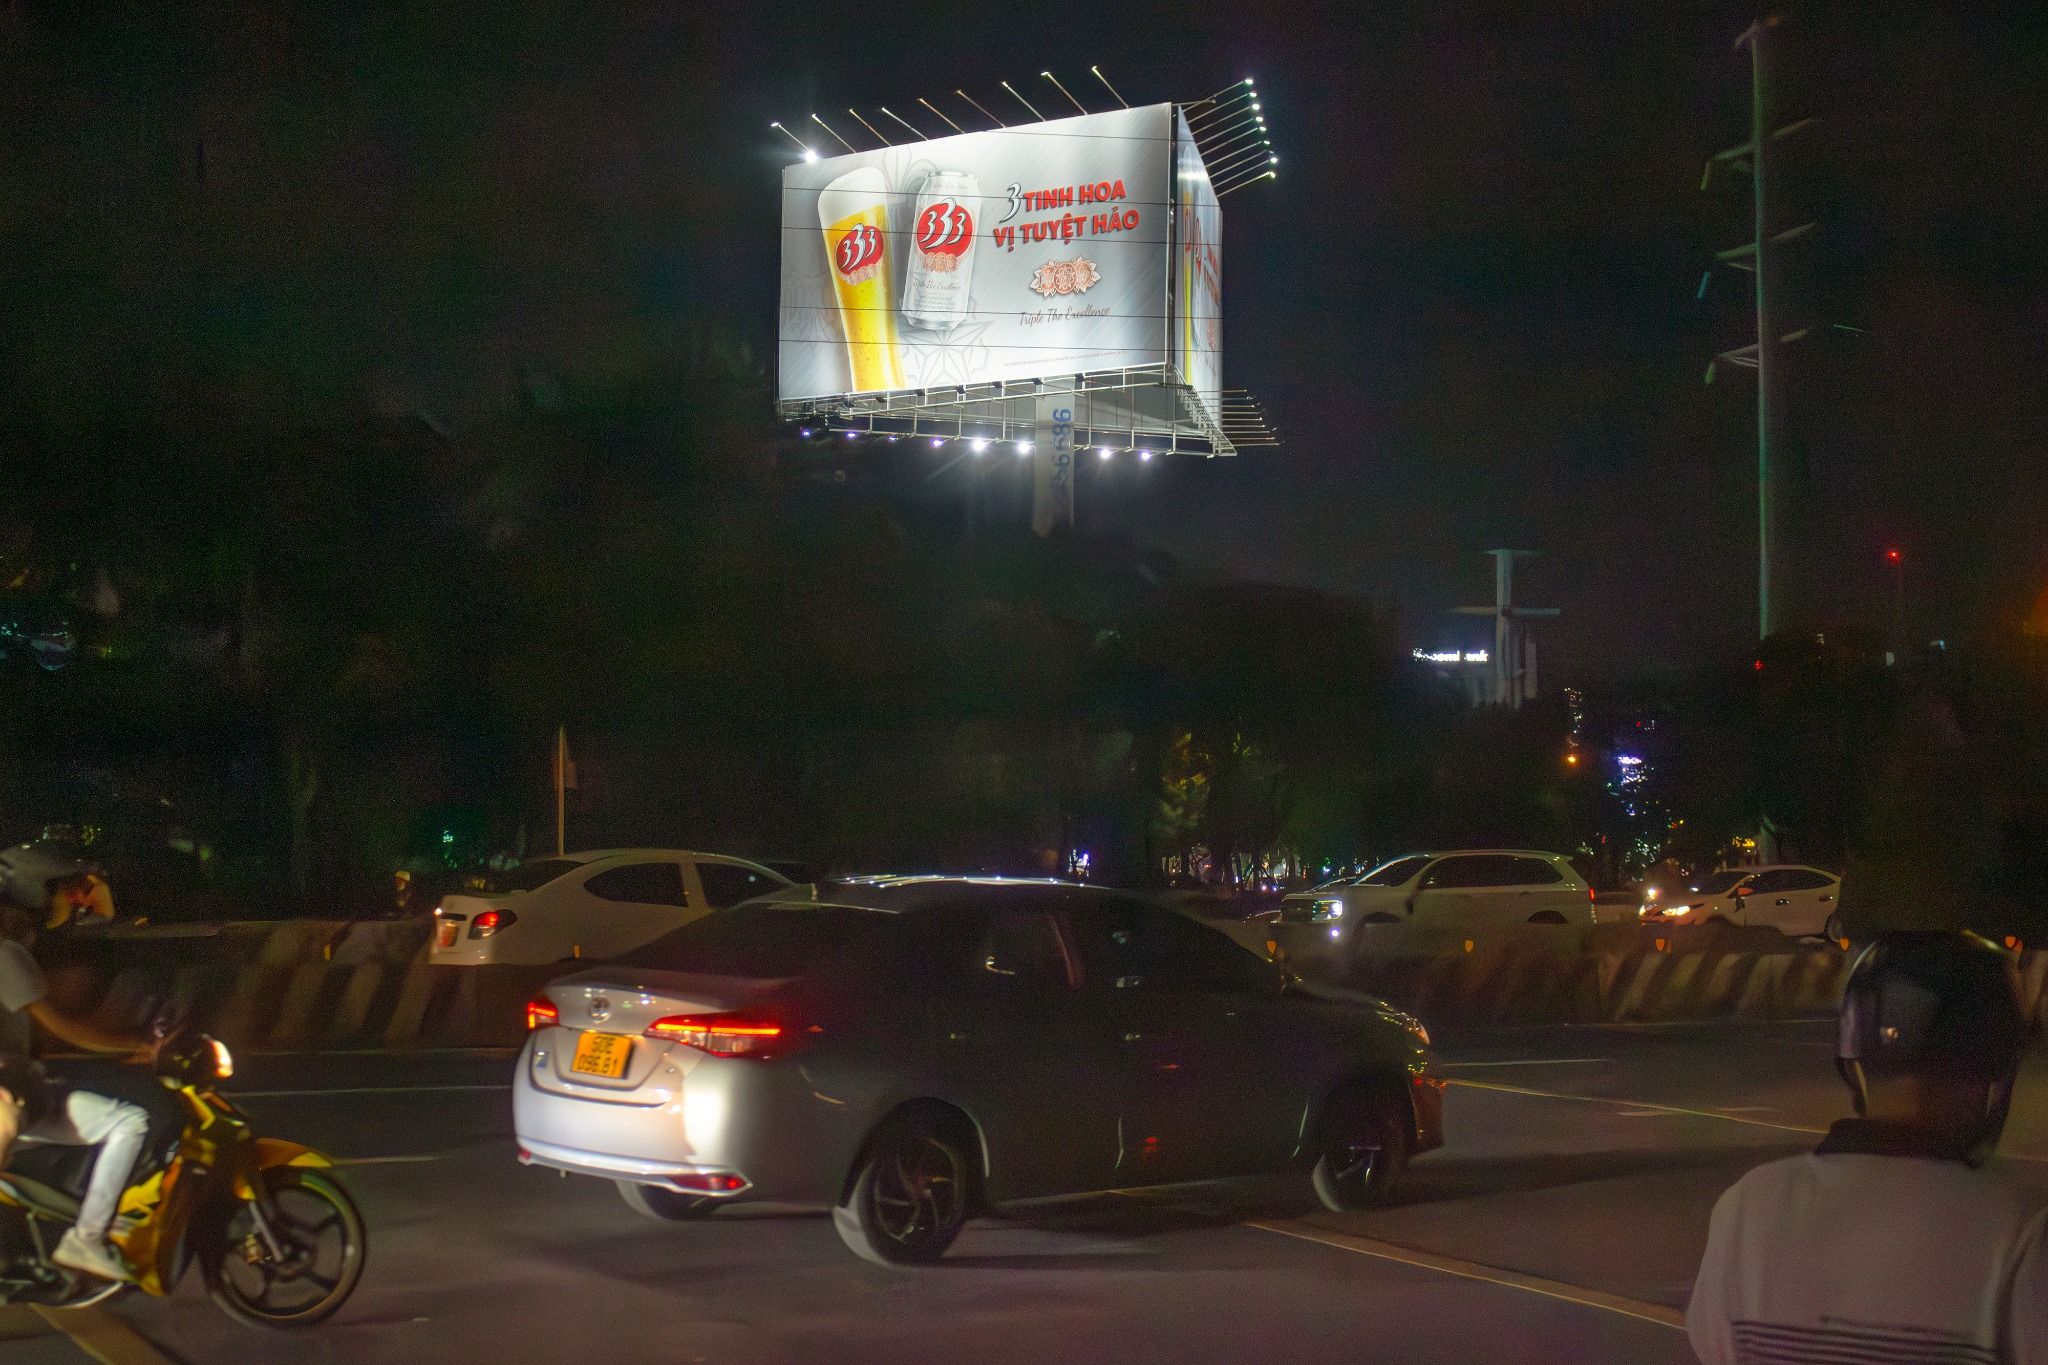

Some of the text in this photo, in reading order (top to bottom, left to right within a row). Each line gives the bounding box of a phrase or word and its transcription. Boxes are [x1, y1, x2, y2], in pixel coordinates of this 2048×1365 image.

[919, 197, 967, 250] 333
[998, 179, 1127, 224] 3 TINH HOA
[841, 222, 877, 271] 333
[993, 225, 1015, 252] VỊ
[1020, 212, 1088, 245] TUYỆT
[1048, 307, 1063, 323] The
